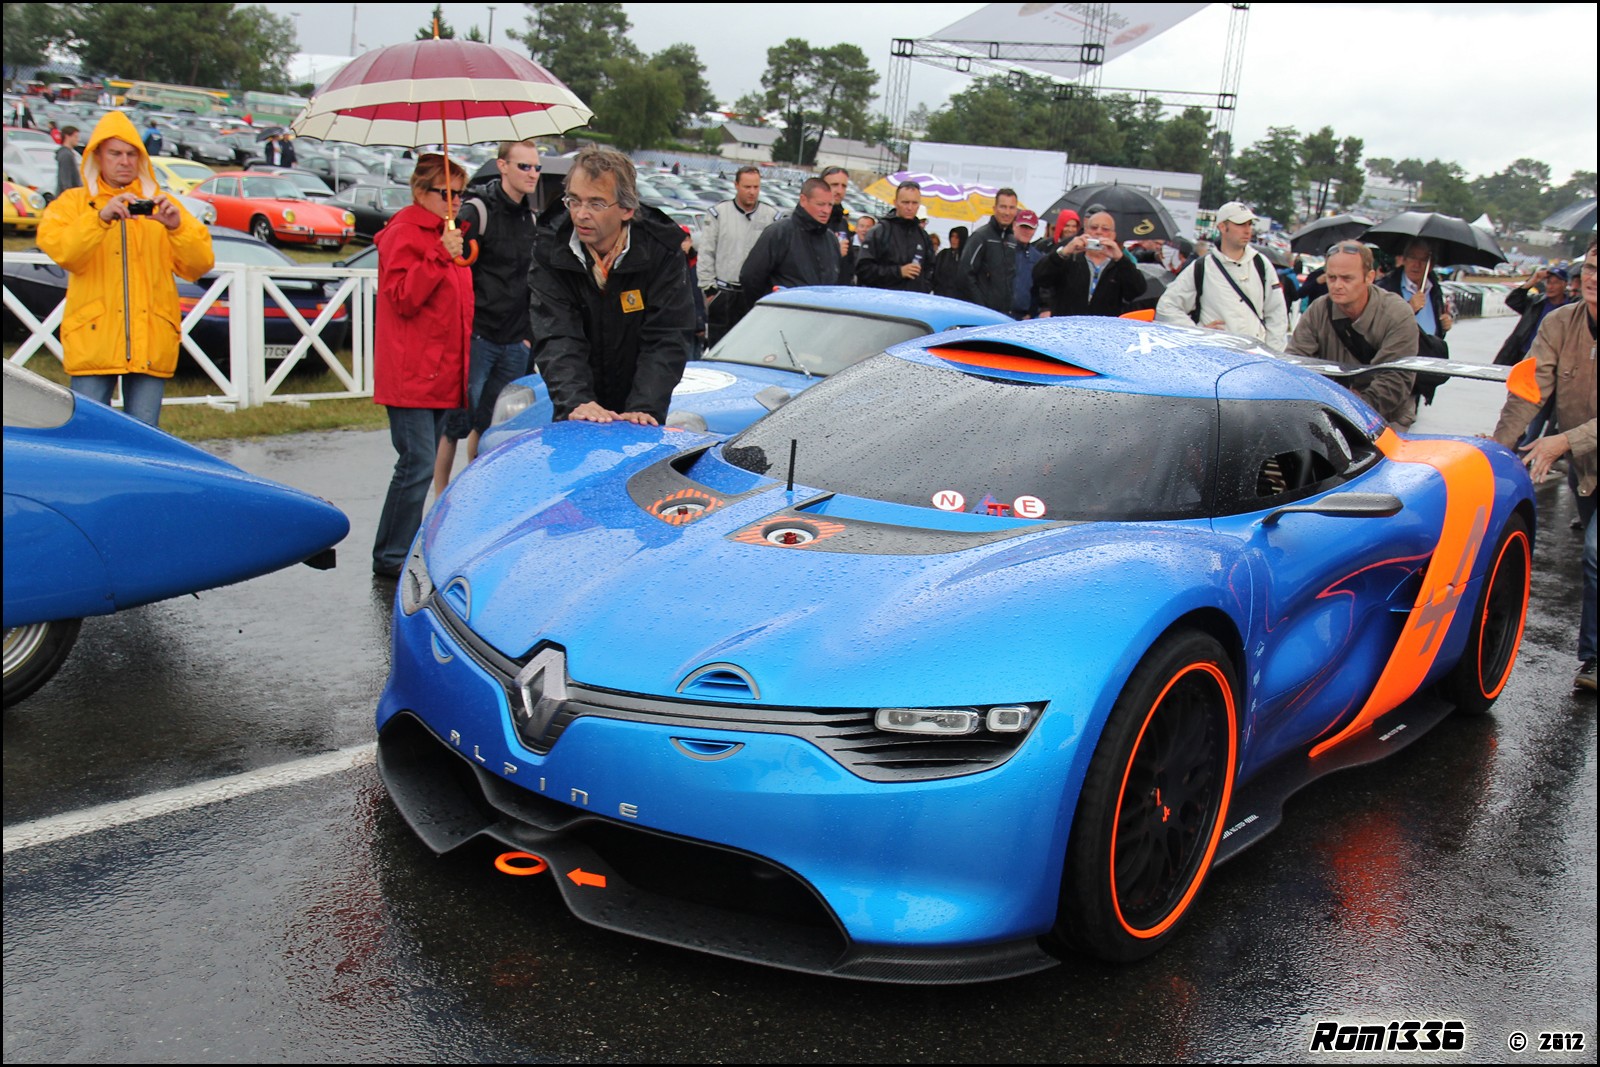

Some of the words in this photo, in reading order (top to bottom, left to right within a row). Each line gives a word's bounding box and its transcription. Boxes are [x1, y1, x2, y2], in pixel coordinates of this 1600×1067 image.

[940, 493, 957, 507] N
[1022, 499, 1038, 514] E
[449, 729, 638, 819] ALPINE
